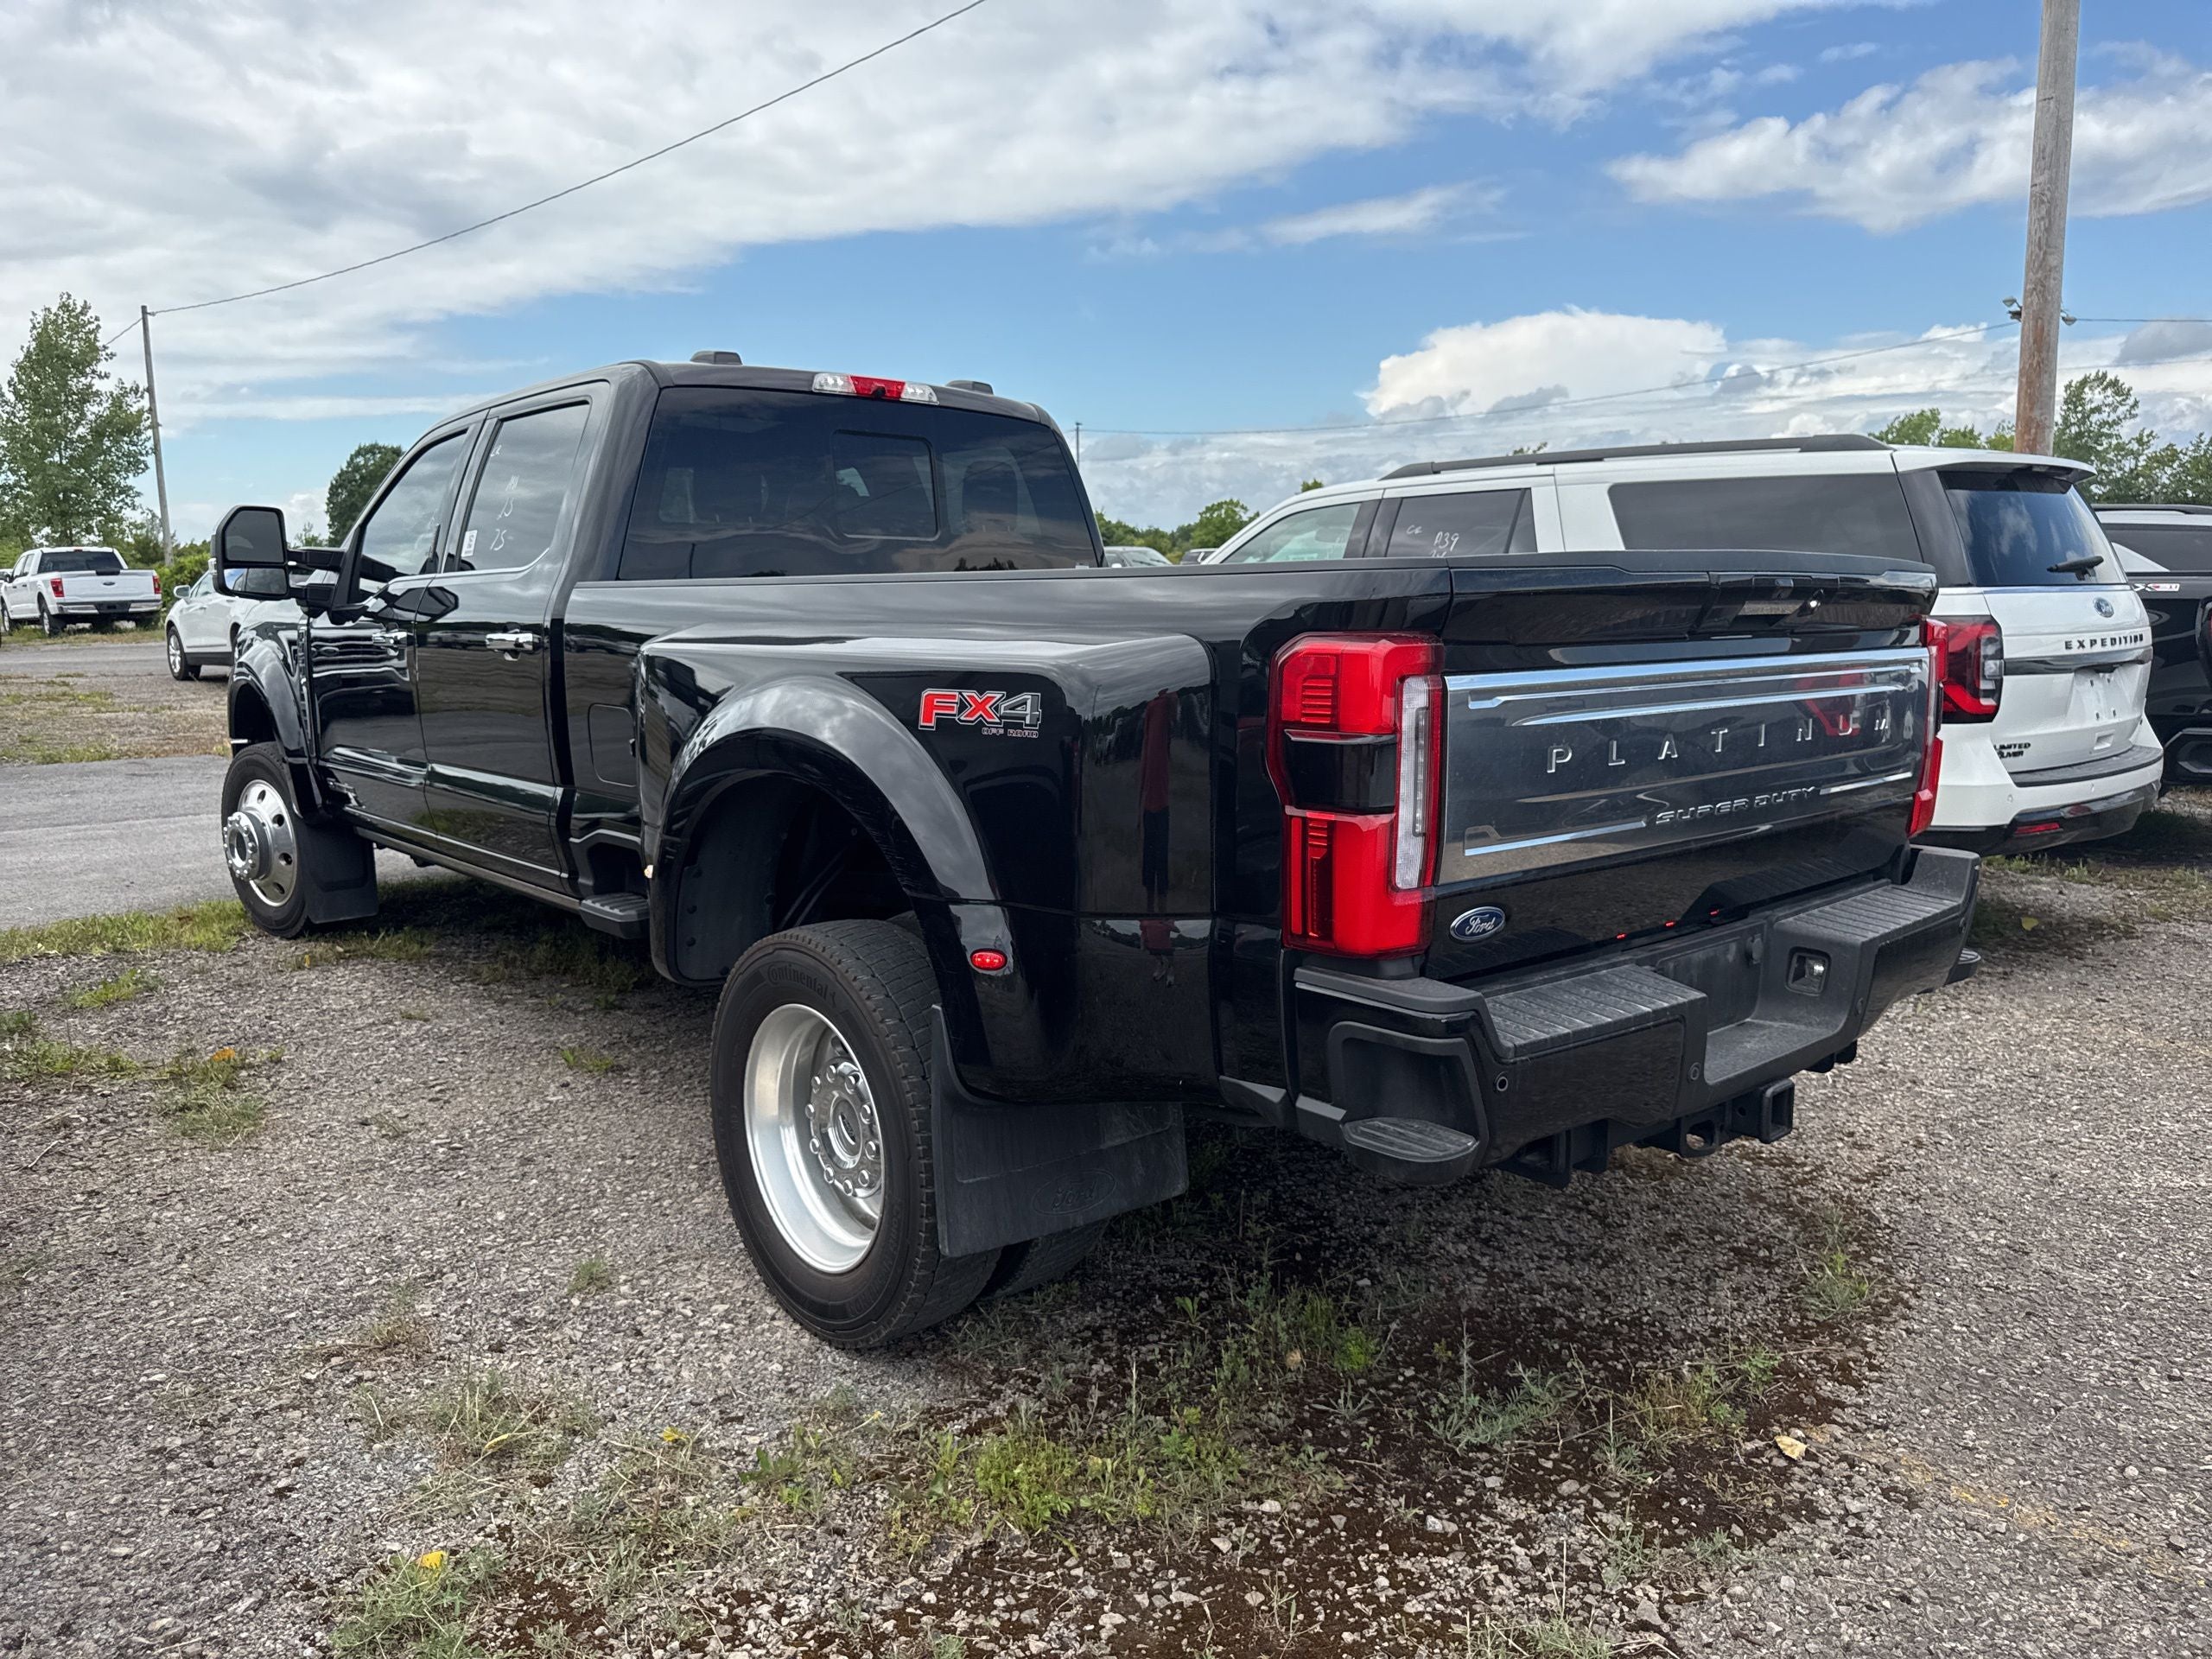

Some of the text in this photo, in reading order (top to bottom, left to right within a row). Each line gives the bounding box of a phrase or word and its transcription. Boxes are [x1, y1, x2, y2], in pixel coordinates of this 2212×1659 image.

[2064, 633, 2144, 651] EXPEDITION
[918, 689, 1042, 731] FX4
[982, 727, 1039, 739] OFF ROAD
[1546, 709, 1891, 774] PLATINUM
[1656, 785, 1815, 824] SUPER DUTY
[1465, 913, 1497, 935] Ford
[767, 963, 830, 1001] Continental
